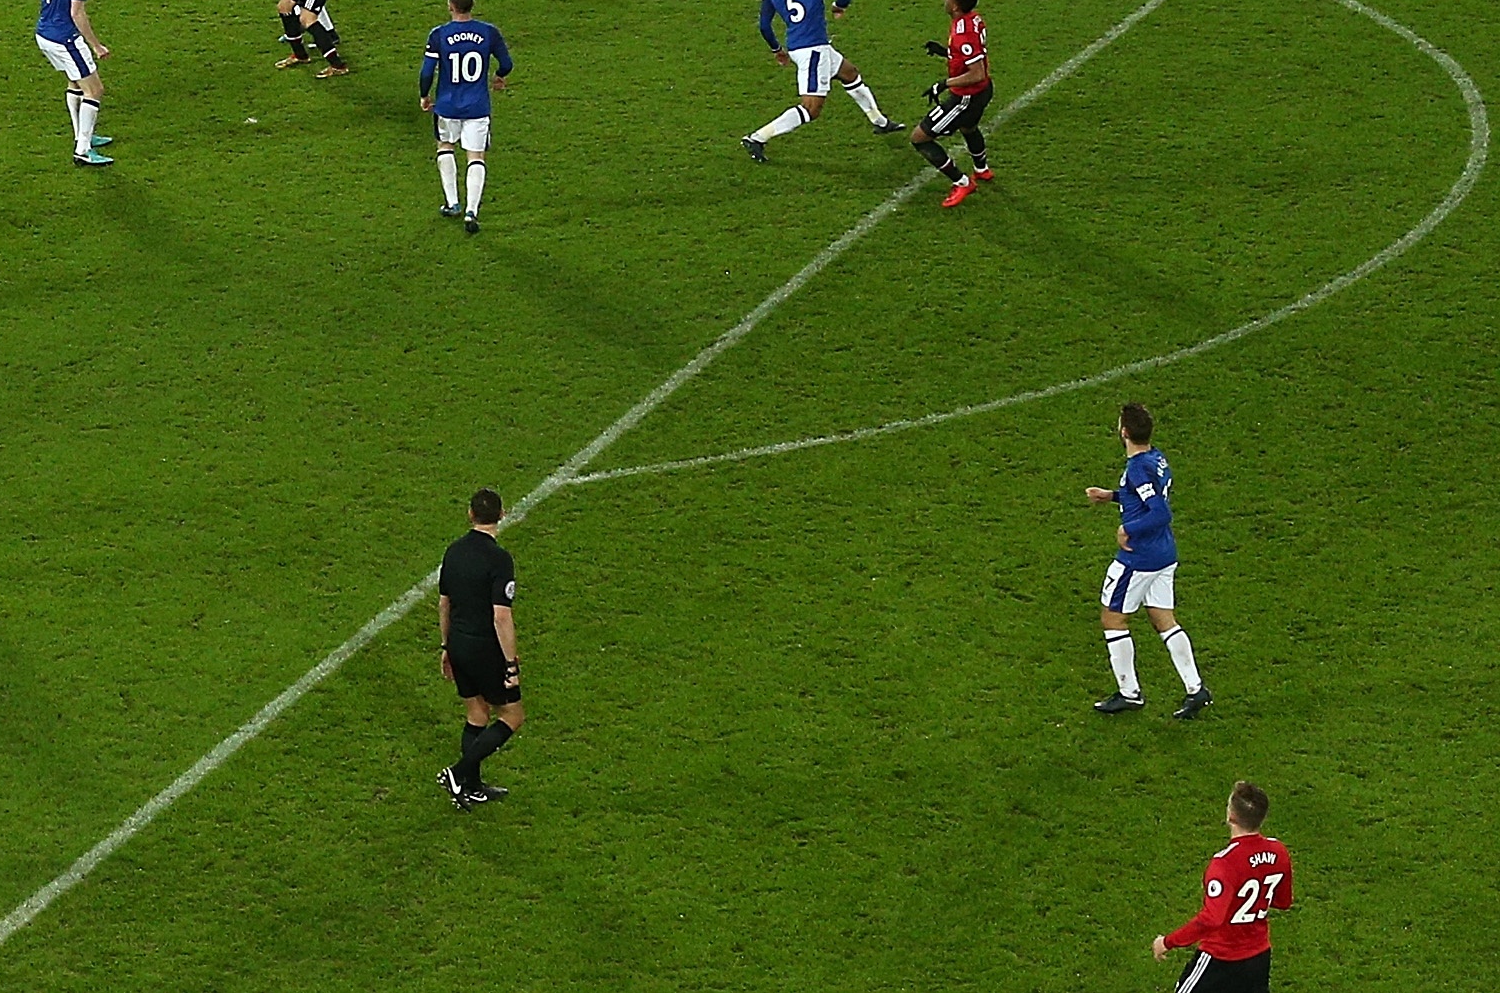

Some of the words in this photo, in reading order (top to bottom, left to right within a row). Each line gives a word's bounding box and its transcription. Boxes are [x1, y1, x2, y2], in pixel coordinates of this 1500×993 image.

[447, 32, 484, 45] ROONEY
[448, 51, 483, 83] 10
[1249, 851, 1277, 868] SHAW
[1230, 873, 1284, 924] 23
